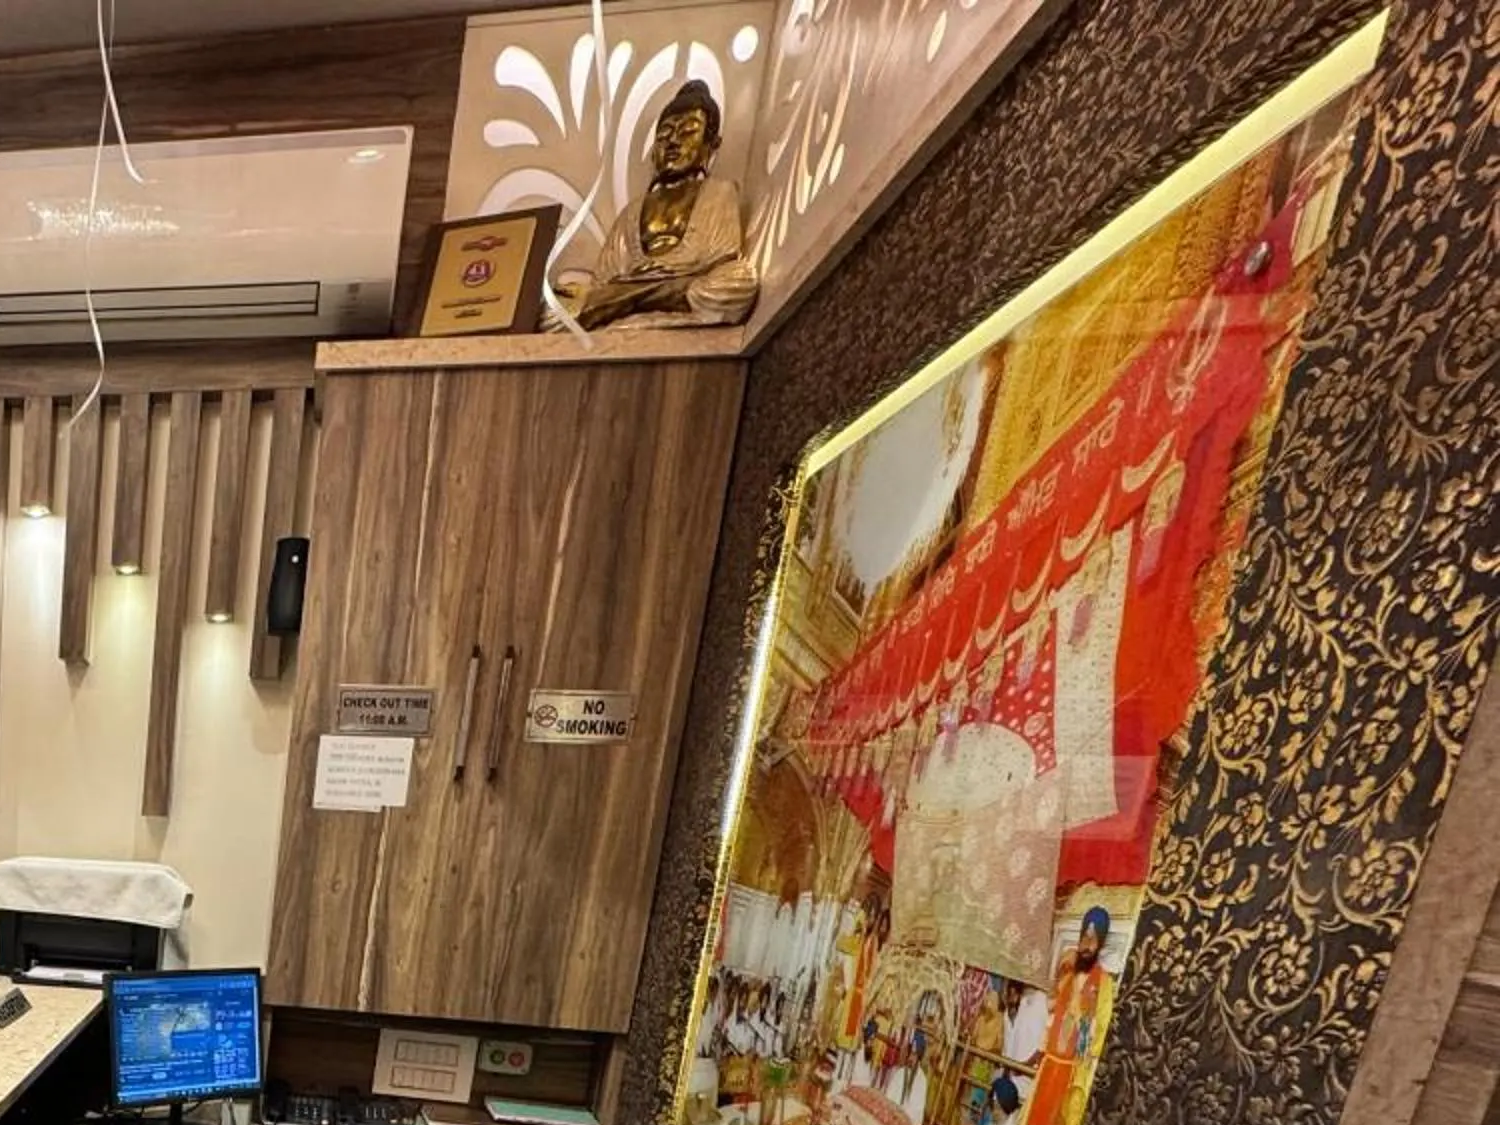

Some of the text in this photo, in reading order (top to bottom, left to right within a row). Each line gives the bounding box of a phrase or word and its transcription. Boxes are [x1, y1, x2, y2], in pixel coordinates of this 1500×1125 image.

[343, 697, 428, 709] CHECK OUT TIME
[583, 699, 605, 715] NO
[556, 719, 627, 736] SMOKING
